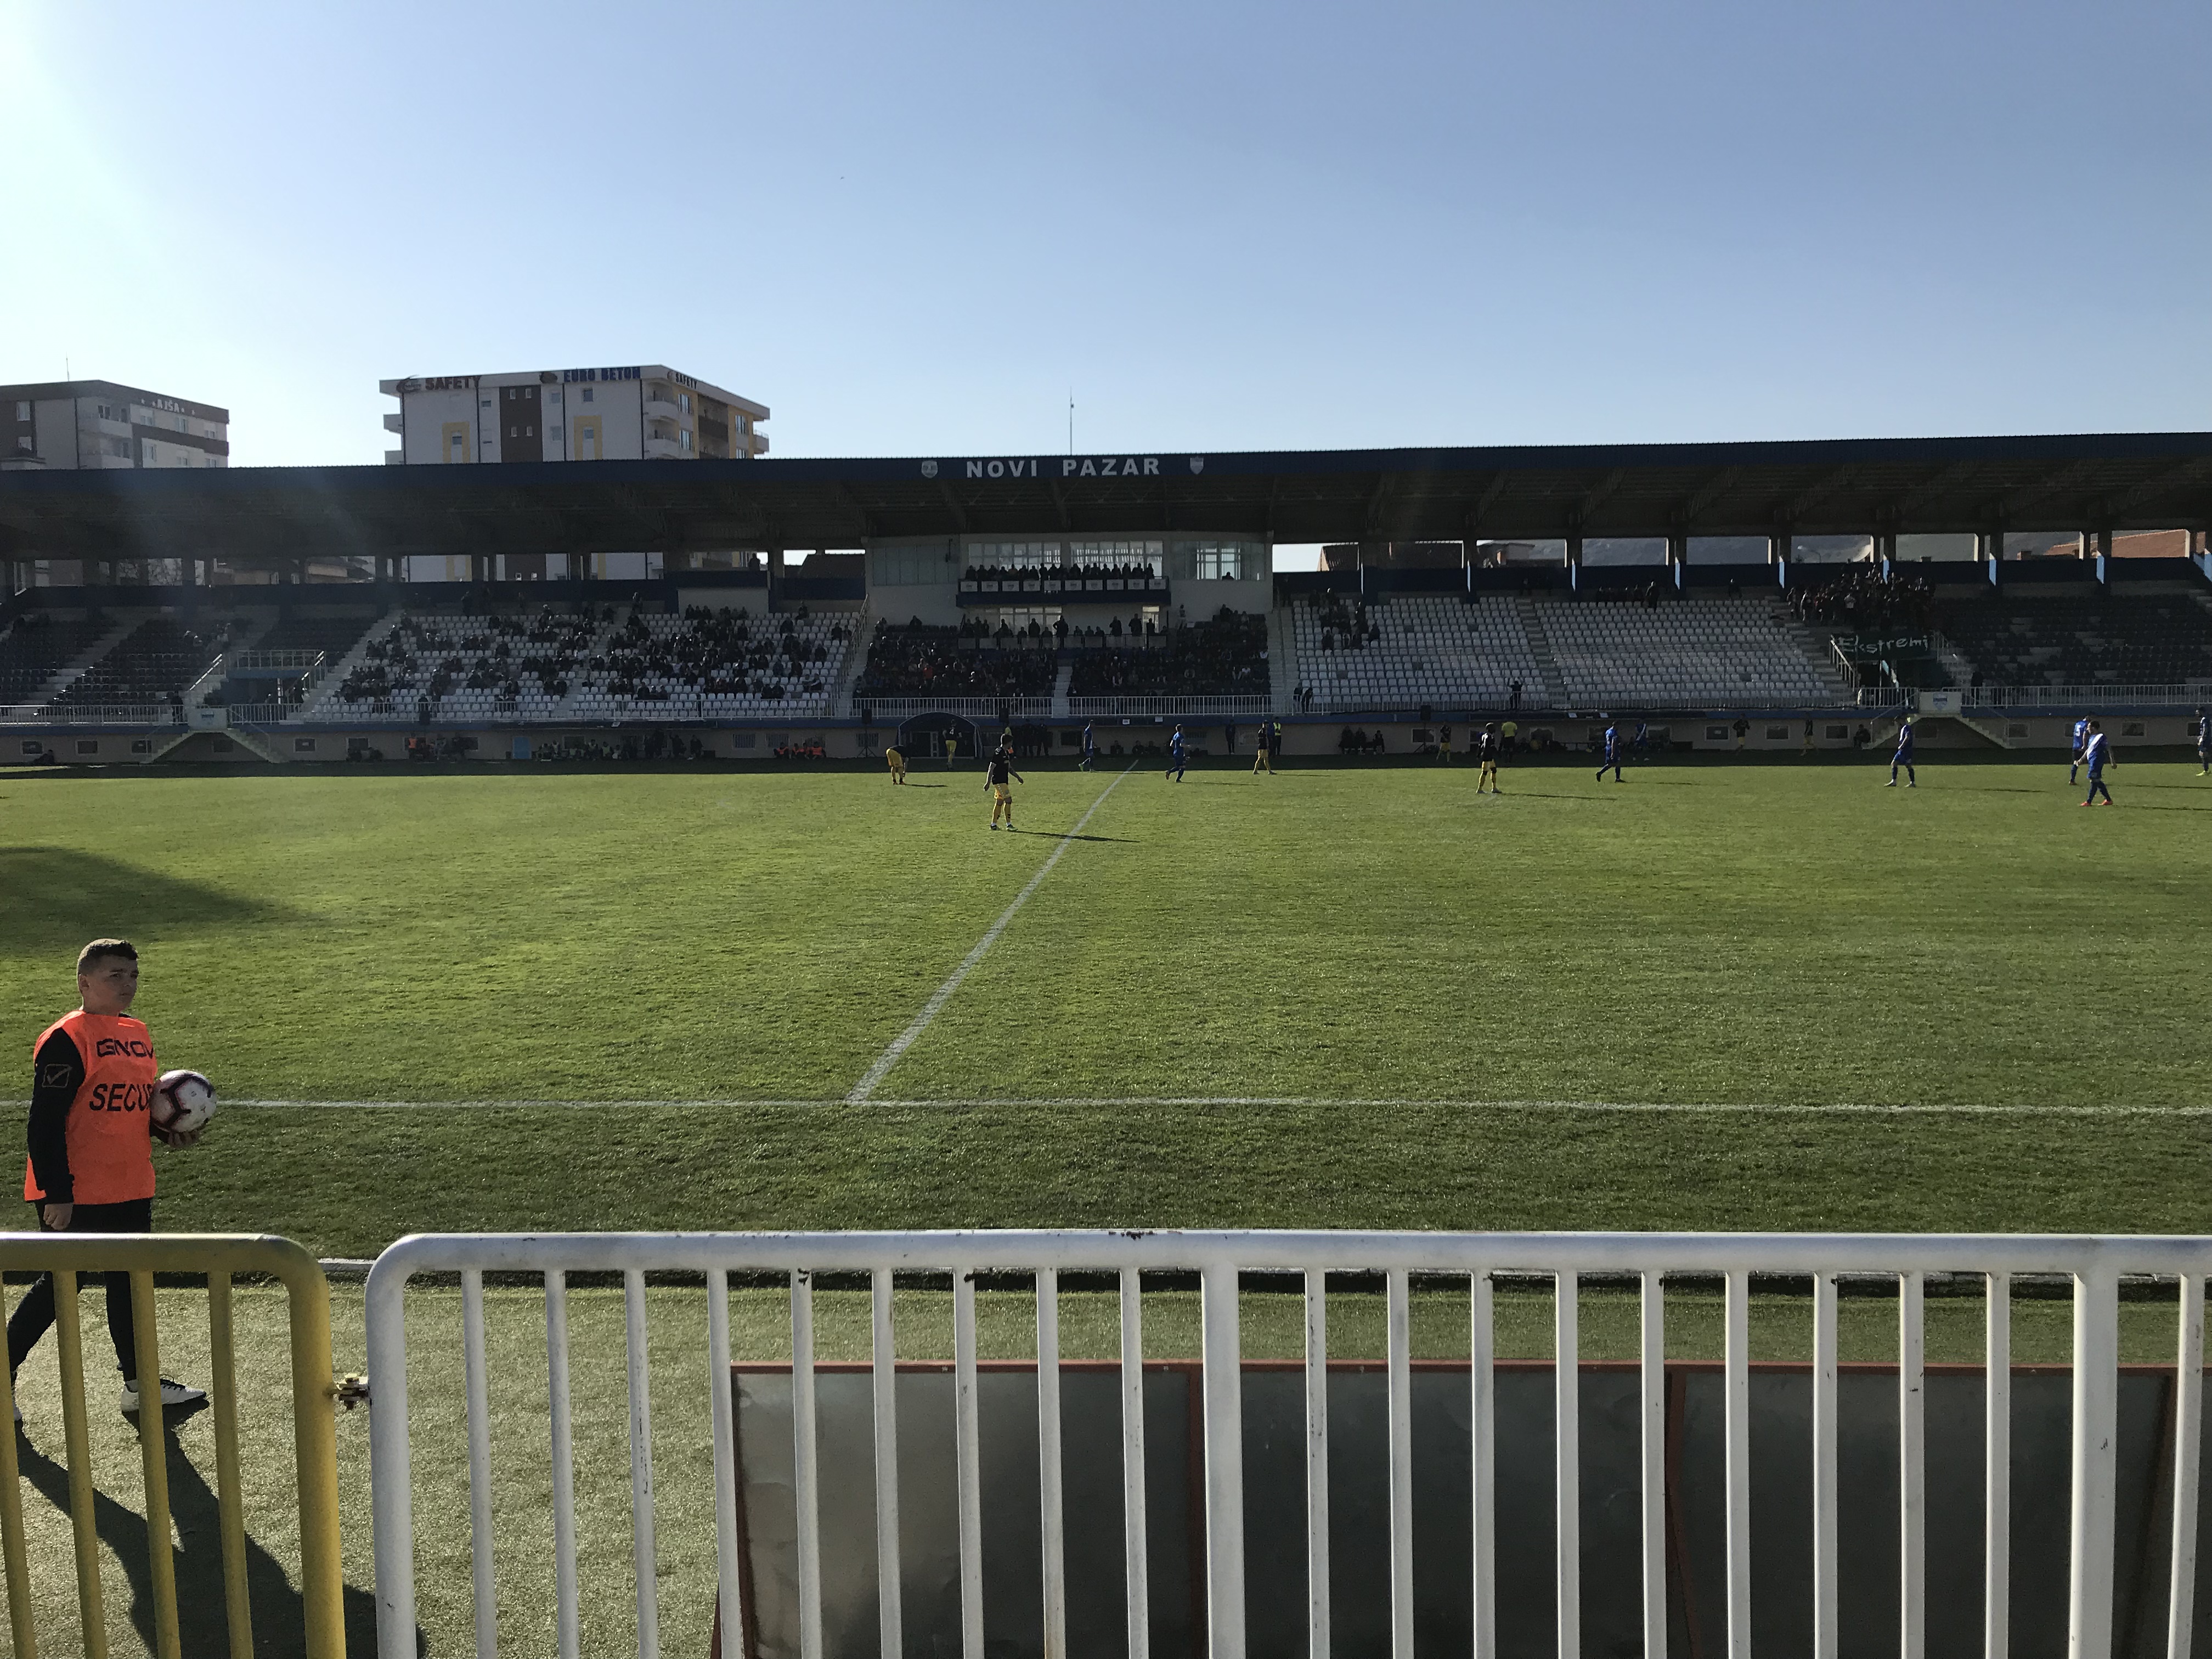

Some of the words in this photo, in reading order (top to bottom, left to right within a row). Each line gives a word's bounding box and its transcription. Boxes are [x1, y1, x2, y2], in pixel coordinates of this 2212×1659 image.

[425, 375, 482, 390] SAFETY
[563, 368, 596, 383] EURO
[601, 366, 641, 381] BETON
[675, 372, 697, 390] SAFETY
[967, 460, 1037, 478] NOVI
[1063, 458, 1160, 476] PAZAR
[1838, 635, 1928, 655] Ekstremi
